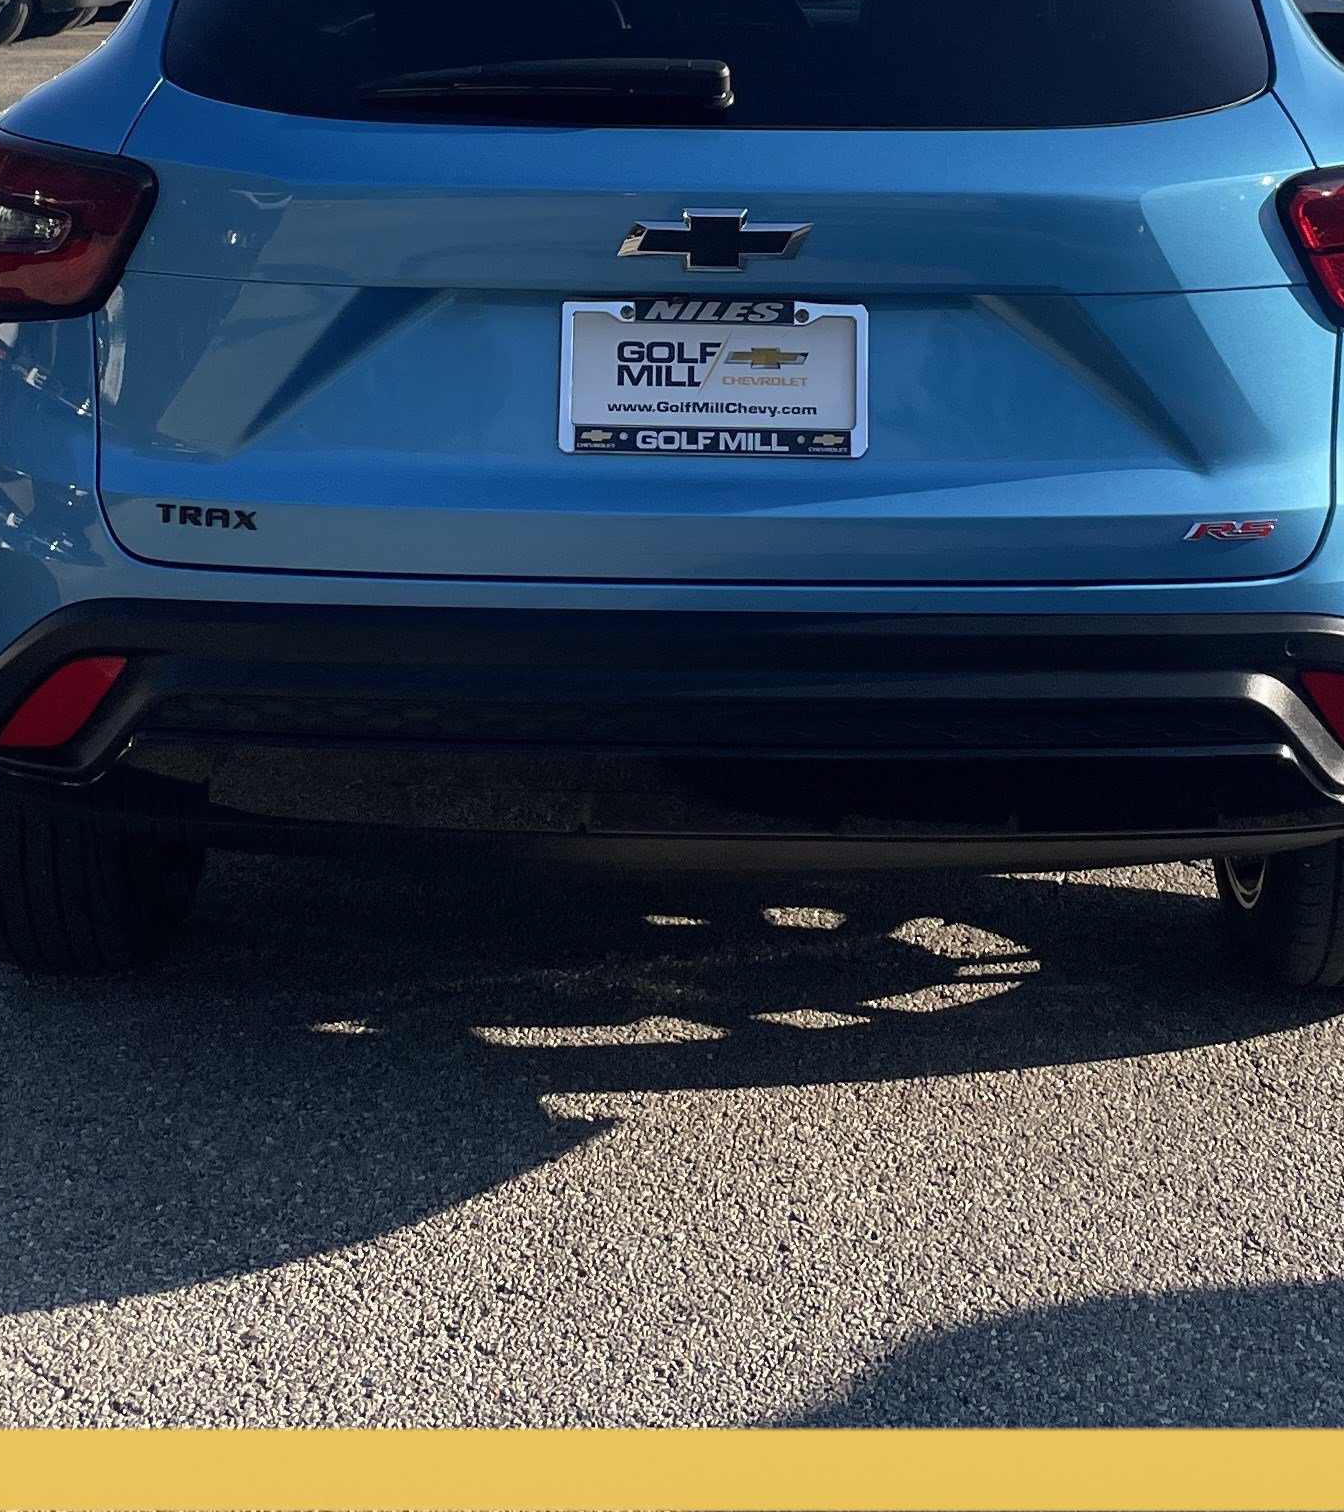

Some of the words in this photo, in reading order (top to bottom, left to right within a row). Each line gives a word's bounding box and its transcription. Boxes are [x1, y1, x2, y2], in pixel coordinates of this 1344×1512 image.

[644, 300, 784, 323] NILES
[616, 341, 723, 364] GOLF
[616, 364, 702, 388] MILL
[721, 375, 809, 387] CHEVROLET
[607, 401, 818, 417] www.GolfMillChevy.com
[636, 430, 715, 450] GOLF
[719, 432, 790, 452] MILL
[156, 503, 258, 531] TRAX
[1181, 518, 1279, 541] RS
